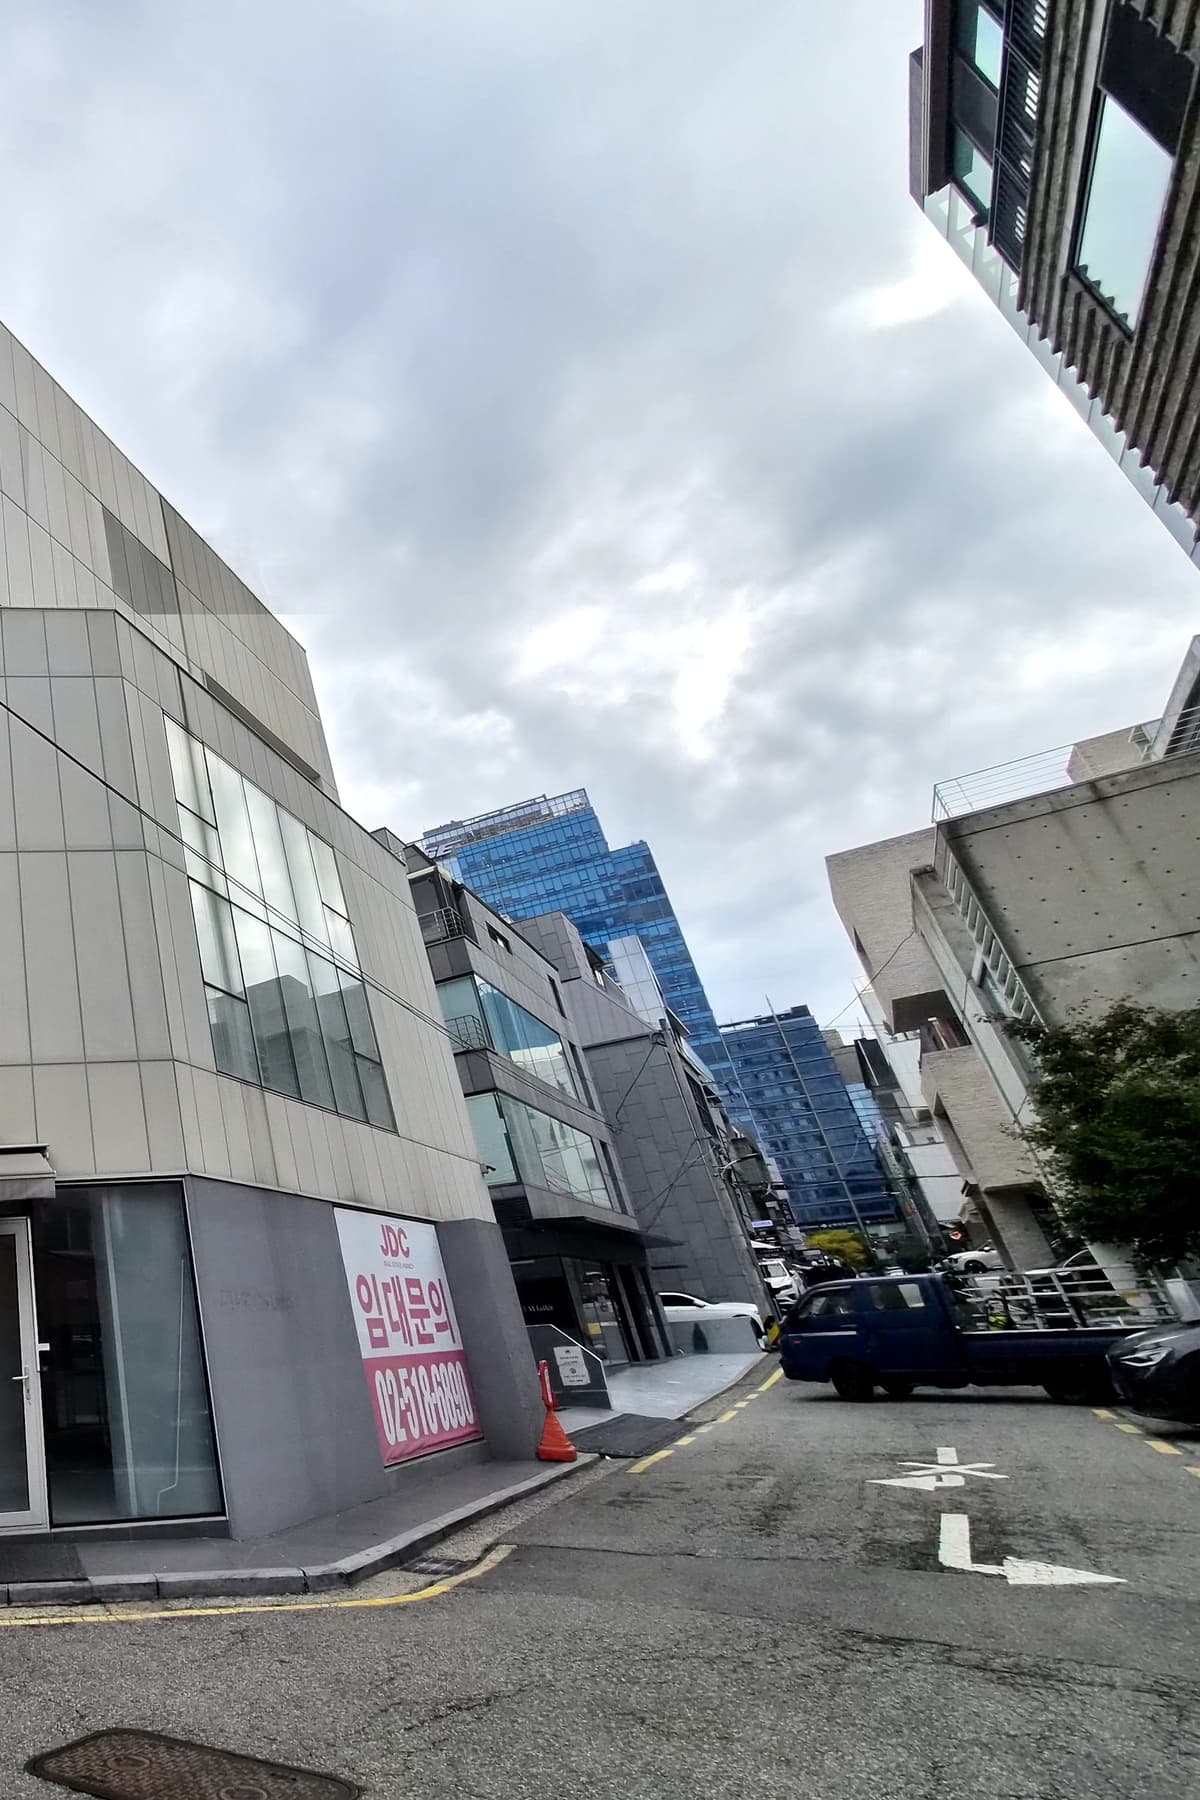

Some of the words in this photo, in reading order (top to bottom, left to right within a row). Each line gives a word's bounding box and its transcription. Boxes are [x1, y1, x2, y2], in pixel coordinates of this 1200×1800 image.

[380, 1224, 410, 1258] JDC
[356, 1274, 456, 1349] 임대문의
[375, 1361, 474, 1446] 02-518-6890
